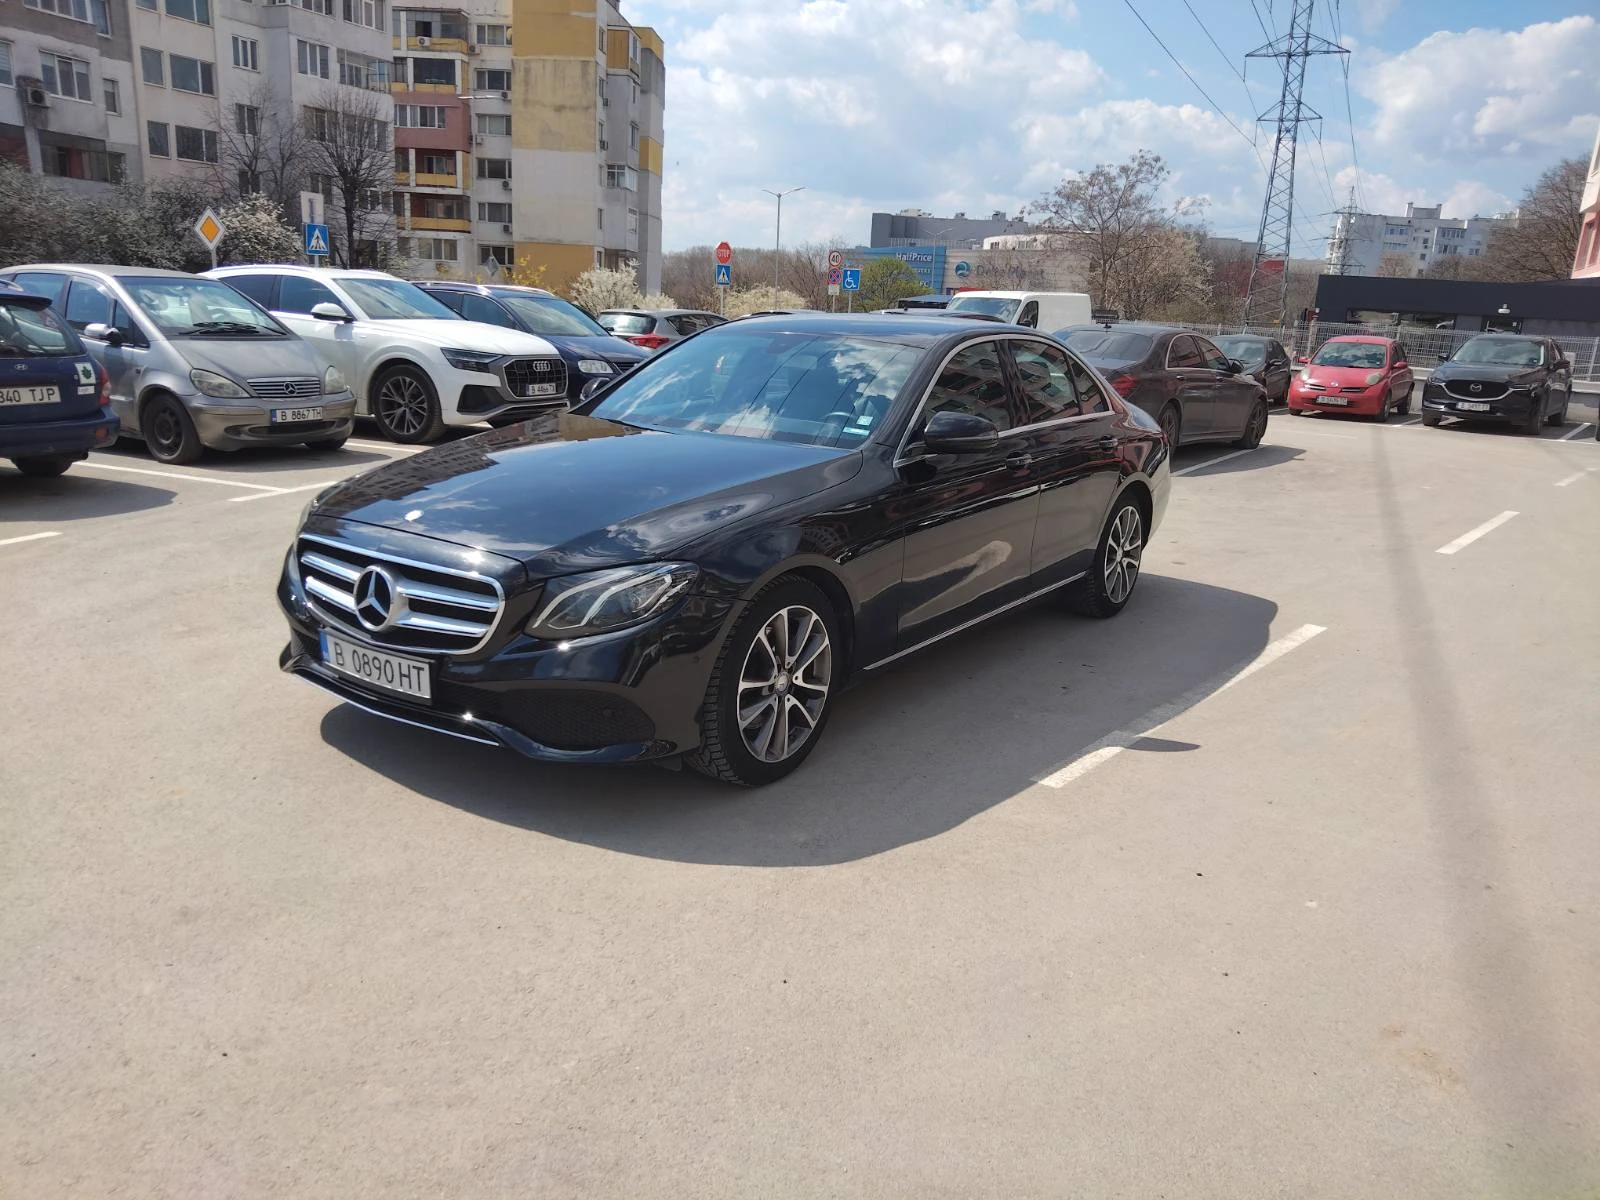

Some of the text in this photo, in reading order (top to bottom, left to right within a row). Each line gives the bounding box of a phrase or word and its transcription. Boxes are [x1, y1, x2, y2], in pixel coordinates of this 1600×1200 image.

[717, 249, 730, 258] STOP
[831, 254, 839, 263] 40
[896, 252, 933, 262] HalfPrice
[28, 388, 55, 402] TJP
[281, 411, 287, 420] B
[291, 409, 310, 420] 8867
[334, 642, 425, 692] B 0890 HT
